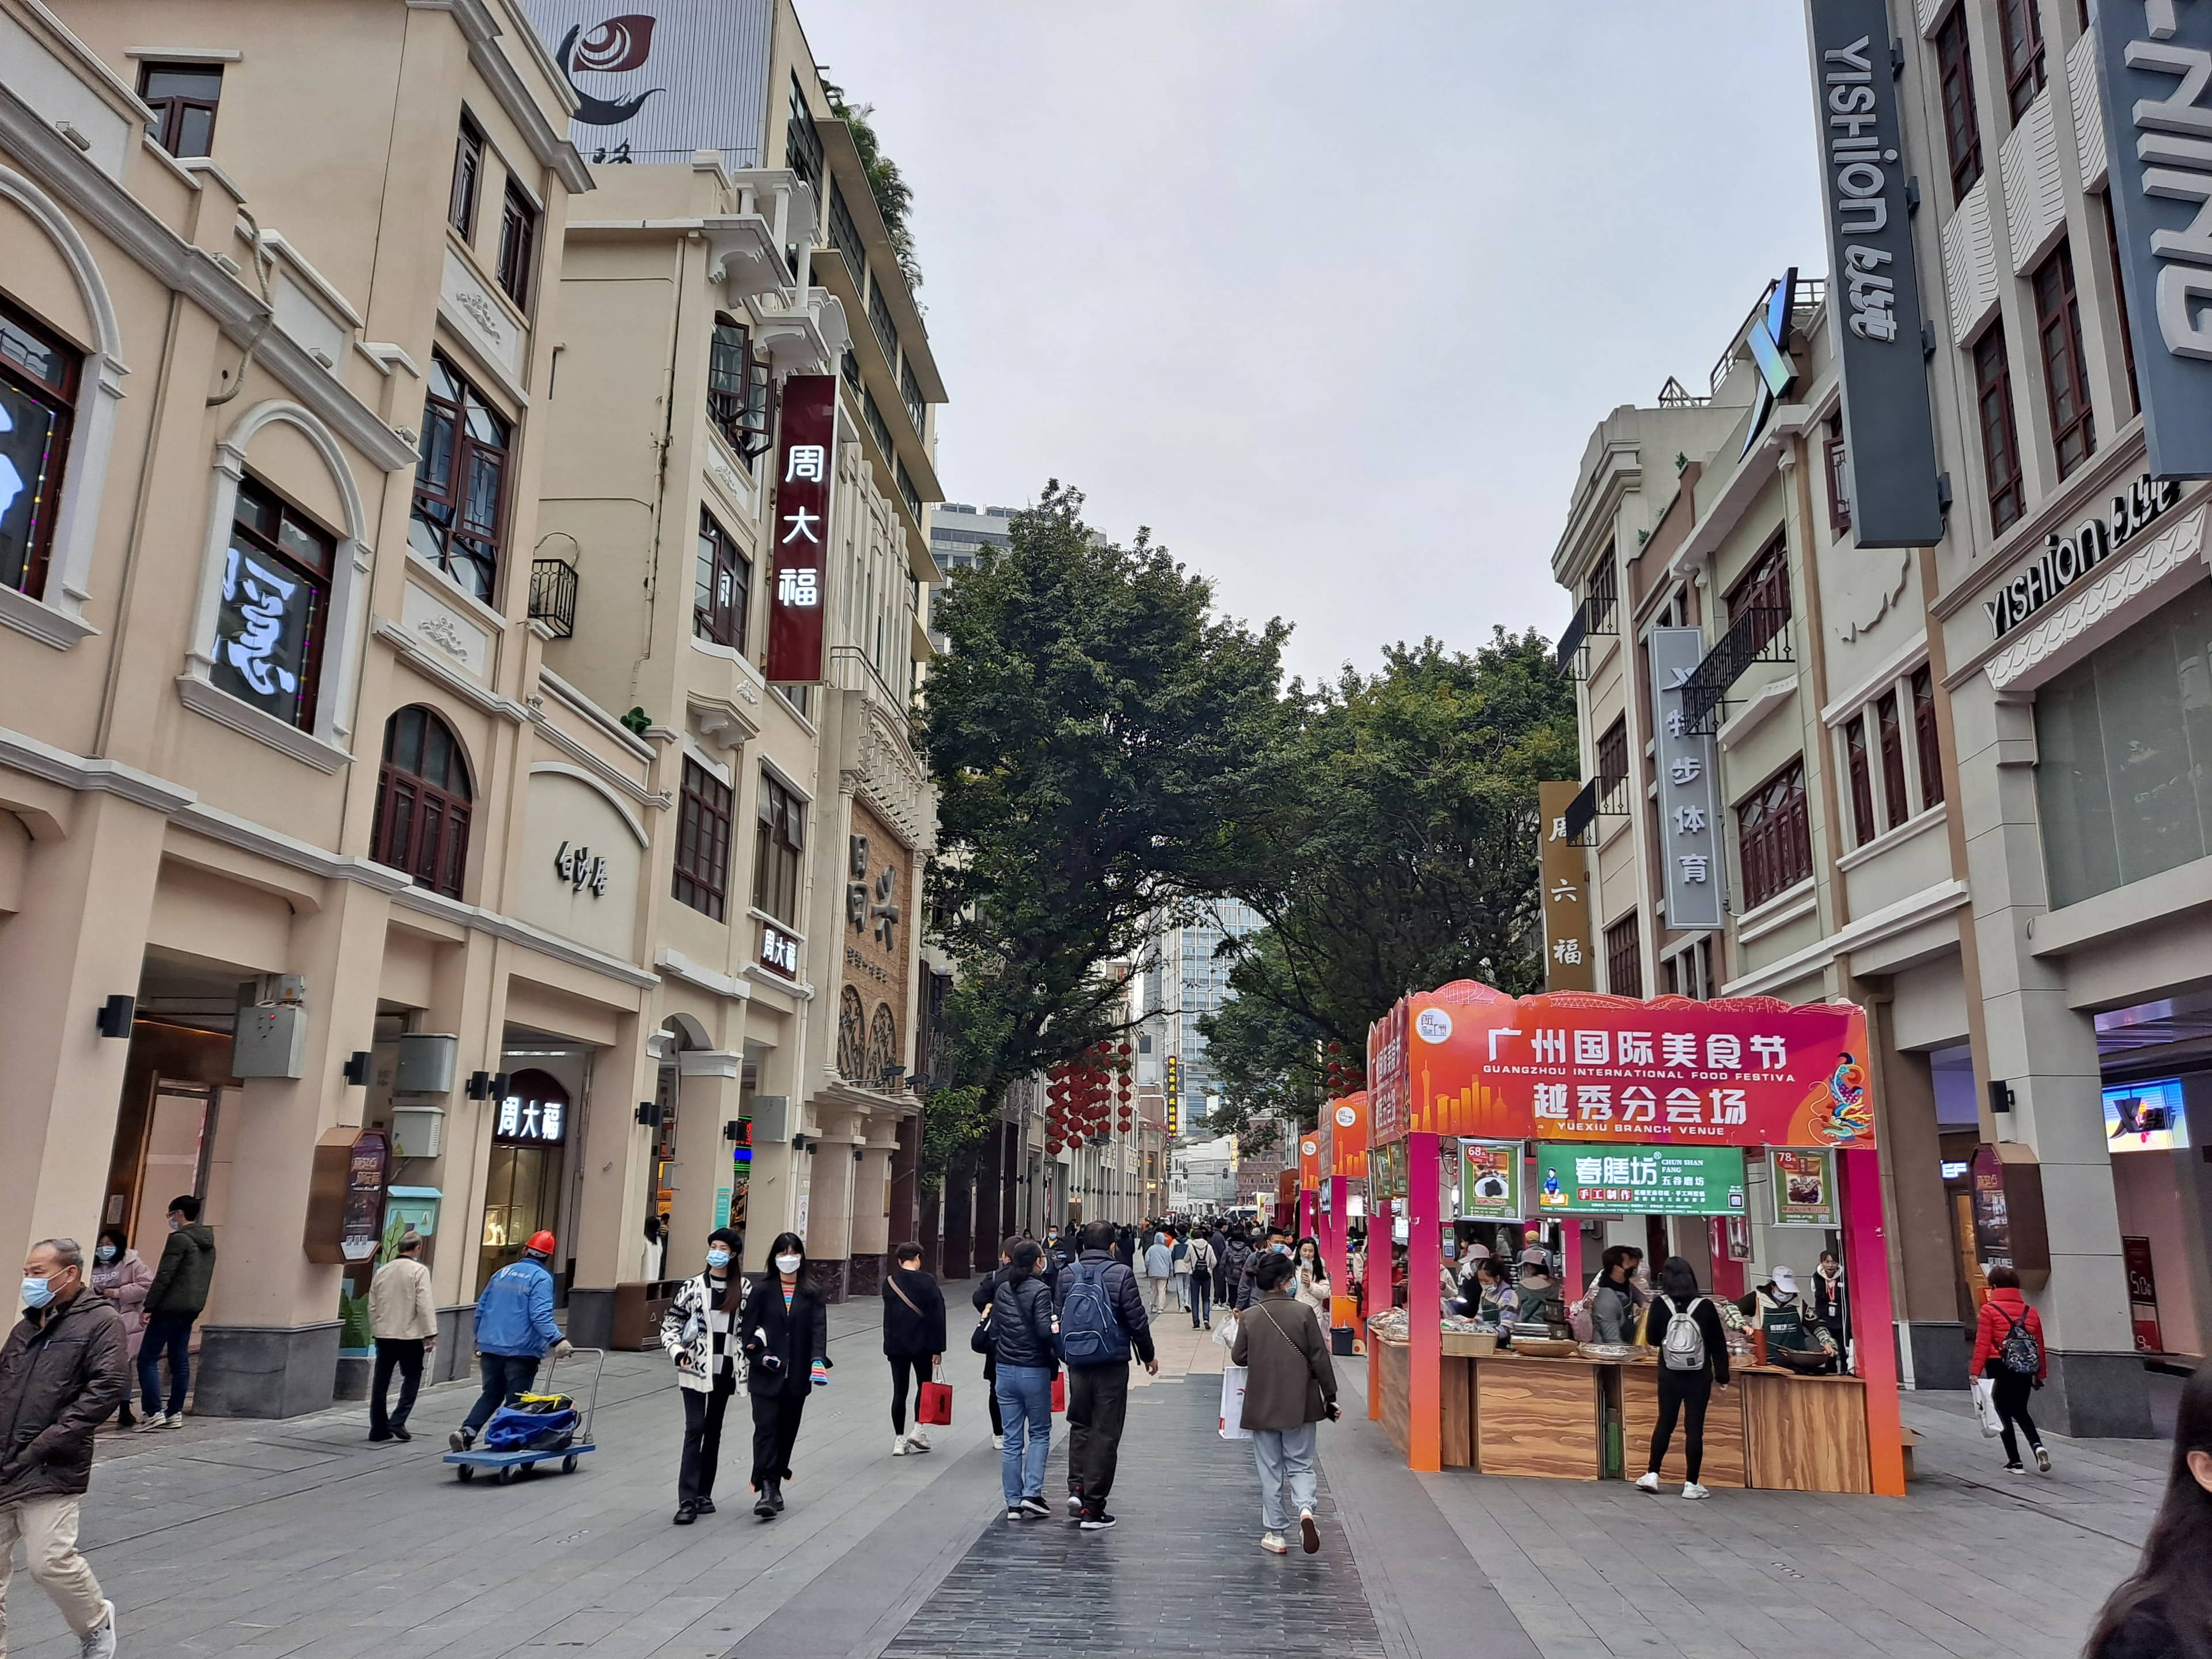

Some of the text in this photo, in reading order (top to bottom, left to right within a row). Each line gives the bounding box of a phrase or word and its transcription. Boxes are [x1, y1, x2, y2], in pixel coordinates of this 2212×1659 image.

[779, 440, 824, 606] 周大福
[763, 929, 797, 972] 周大福
[1488, 1027, 1786, 1070] 广州国际美食节
[1483, 1065, 1796, 1082] GUANGZHOU INTERNATIONAL FOOD FESTIVA
[498, 1096, 561, 1139] 周大福
[1533, 1083, 1747, 1124] 越秀分会场
[1558, 1122, 1724, 1135] YUEXIU BRANCH VENUE
[1575, 1156, 1657, 1185] 春膳坊
[1578, 1188, 1631, 1200] 手工制作
